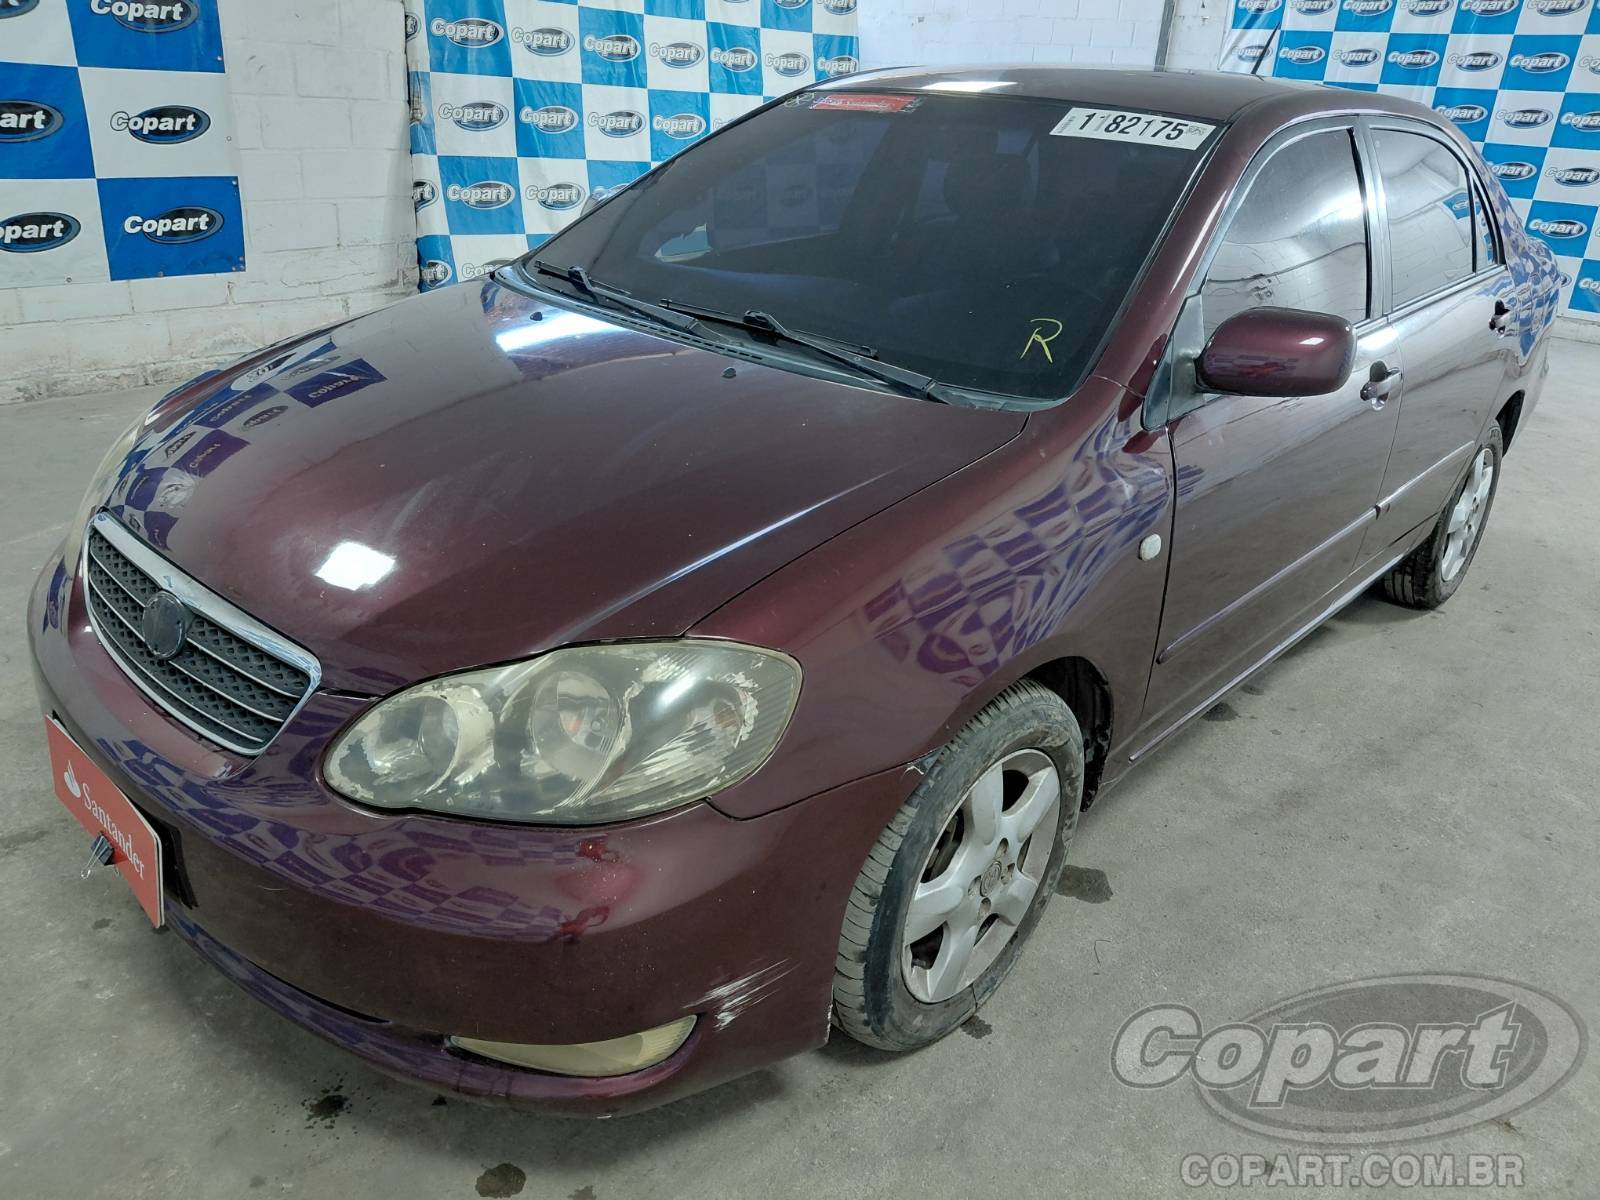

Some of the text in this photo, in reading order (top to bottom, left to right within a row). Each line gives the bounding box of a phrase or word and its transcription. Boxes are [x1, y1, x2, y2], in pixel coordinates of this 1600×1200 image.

[431, 17, 497, 41] Copart
[511, 27, 569, 48] Copart
[583, 35, 636, 57] Copart
[649, 42, 698, 62] Copart
[1279, 47, 1319, 60] Copart
[1333, 49, 1374, 63] Copart
[710, 47, 753, 67] Copart
[764, 52, 804, 70] Copart
[816, 57, 856, 74] Copart
[1387, 51, 1433, 66] Copart
[1447, 53, 1498, 67] Copart
[1510, 54, 1563, 69] Copart
[110, 111, 196, 135] Copart
[438, 102, 500, 124] Copart
[520, 105, 572, 128] Copart
[588, 111, 639, 131] Copart
[1495, 110, 1545, 125] Copart
[653, 114, 699, 133] Copart
[1545, 166, 1597, 182] Copart
[447, 184, 508, 206] Copart
[525, 185, 578, 206] Copart
[124, 213, 209, 236] Copart
[1529, 218, 1581, 235] Copart
[1020, 318, 1063, 363] R
[82, 782, 145, 881] Santander
